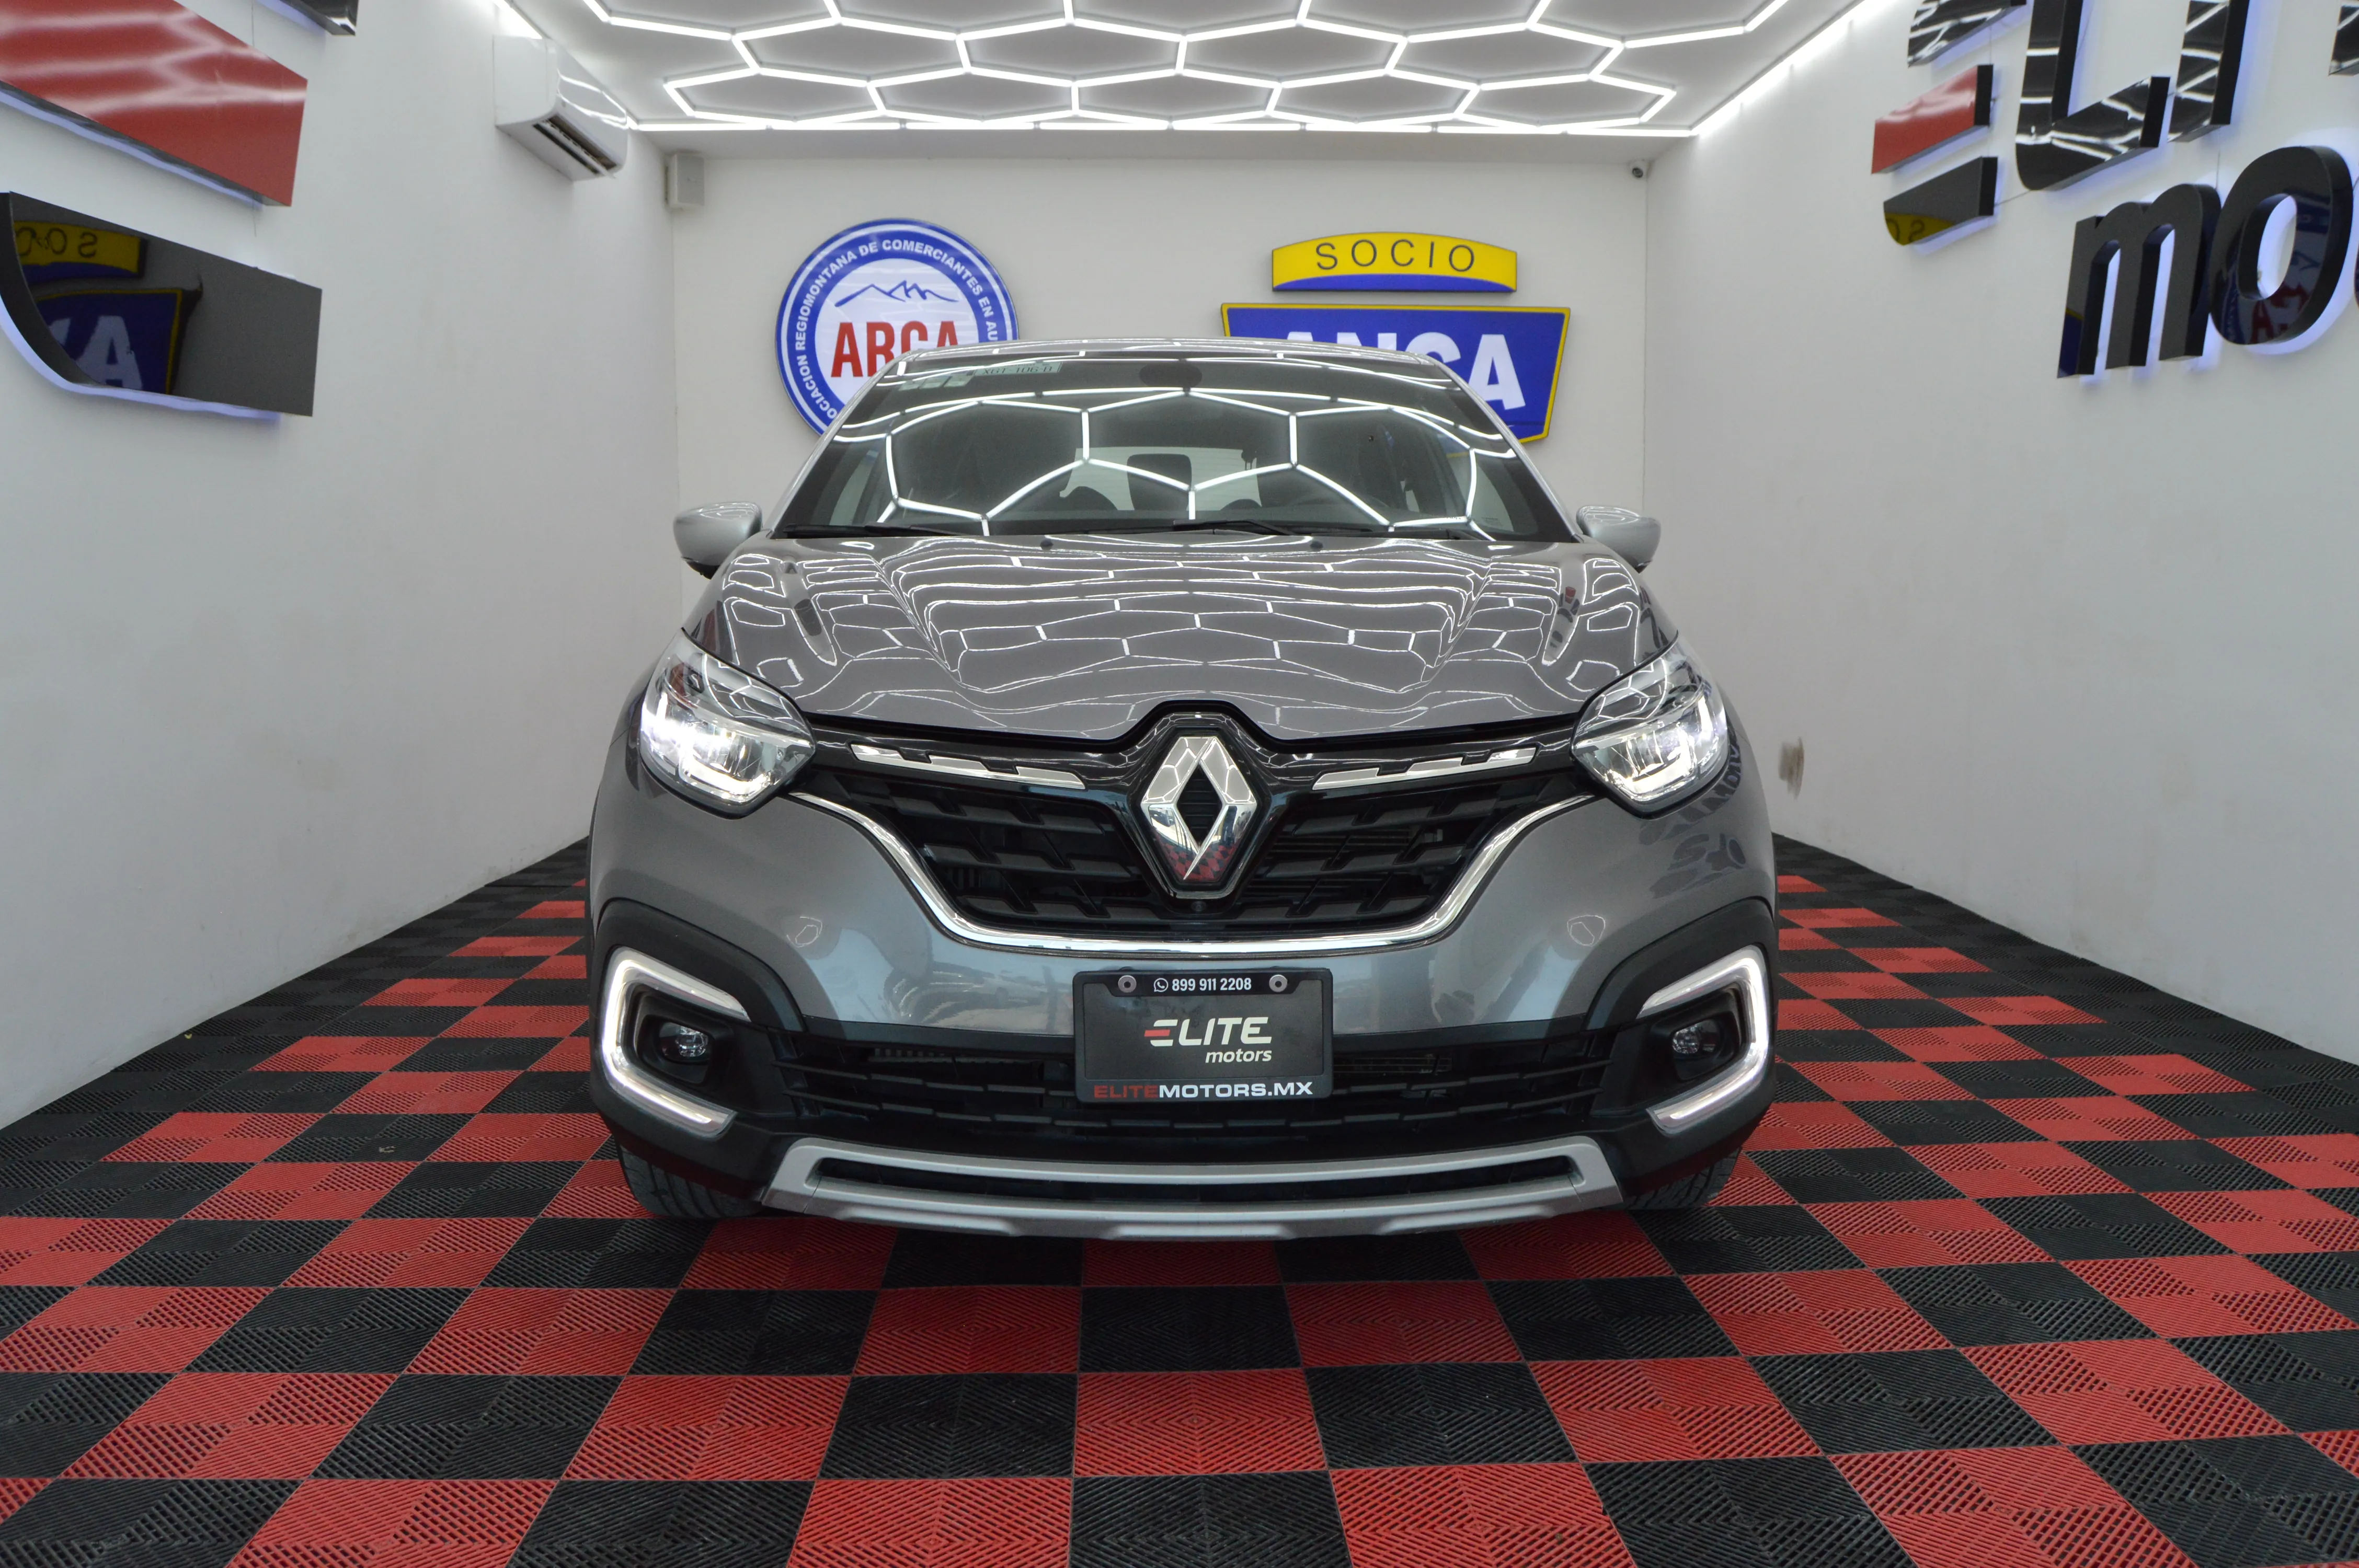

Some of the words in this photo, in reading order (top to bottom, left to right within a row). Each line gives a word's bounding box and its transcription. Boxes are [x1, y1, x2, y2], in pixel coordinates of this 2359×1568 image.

[858, 242, 878, 256] DE
[1315, 239, 1475, 272] SOCIO
[2057, 146, 2359, 377] mo
[882, 239, 983, 295] COMERCIANTES
[795, 251, 857, 350] REGIOMONTANA
[978, 296, 993, 318] EN
[986, 321, 998, 341] AU
[797, 355, 837, 419] OCIACION
[1172, 978, 1196, 991] 899
[1199, 978, 1217, 991] 911
[1220, 977, 1252, 990] 2208
[1144, 1017, 1272, 1046] ELITE
[1205, 1048, 1272, 1063] motors
[1094, 1081, 1313, 1098] ELITEMOTORS.MX
